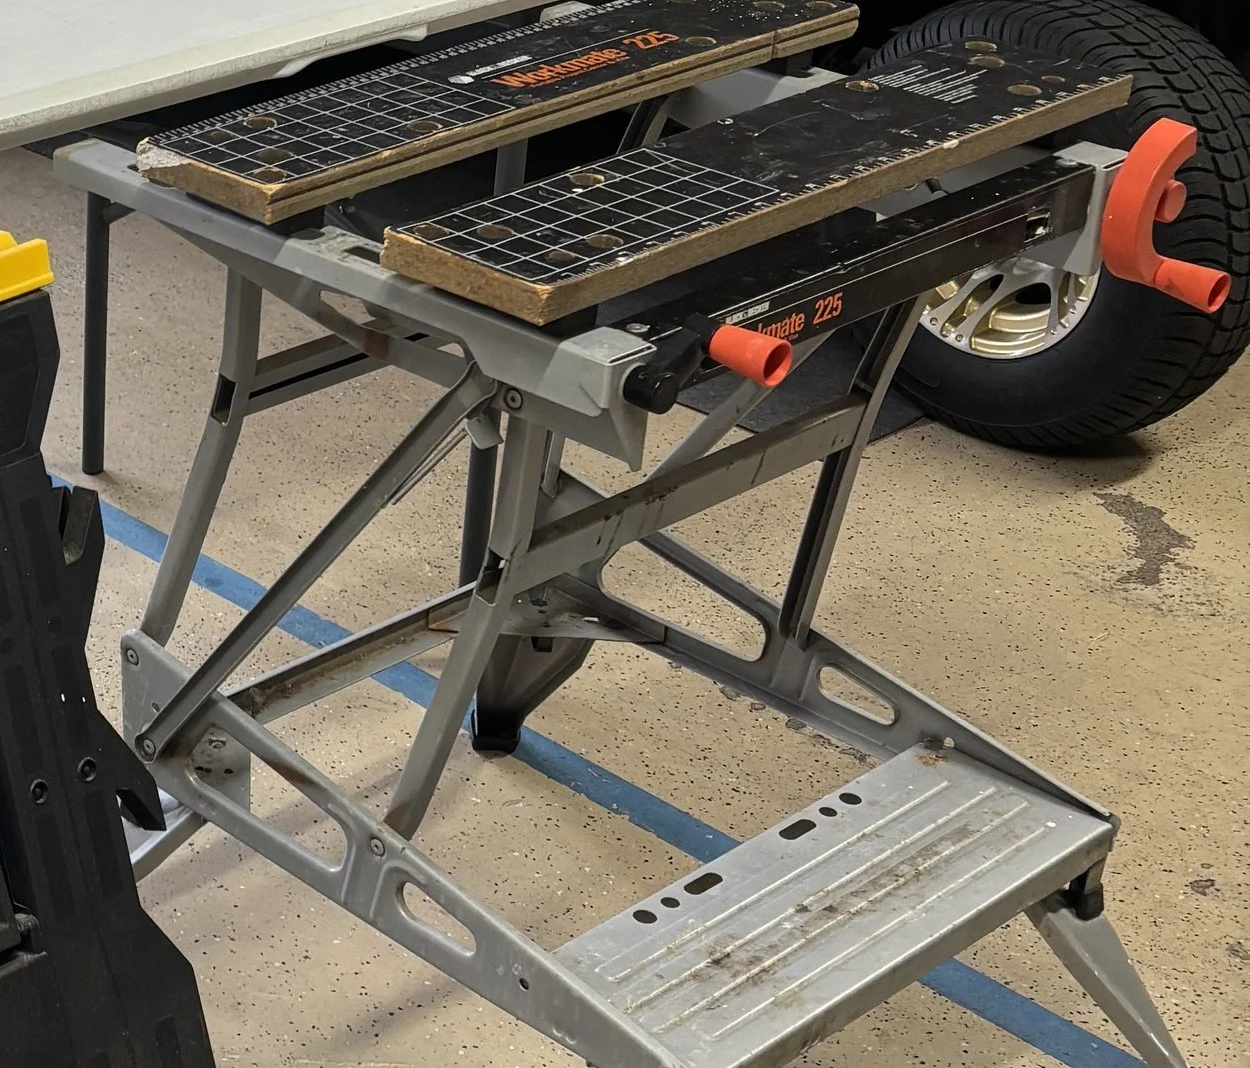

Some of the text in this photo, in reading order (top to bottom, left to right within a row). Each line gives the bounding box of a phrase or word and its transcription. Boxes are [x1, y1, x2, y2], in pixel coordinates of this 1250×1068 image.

[492, 47, 627, 88] Workmate
[622, 30, 680, 51] 225
[758, 292, 843, 340] kmate 225
